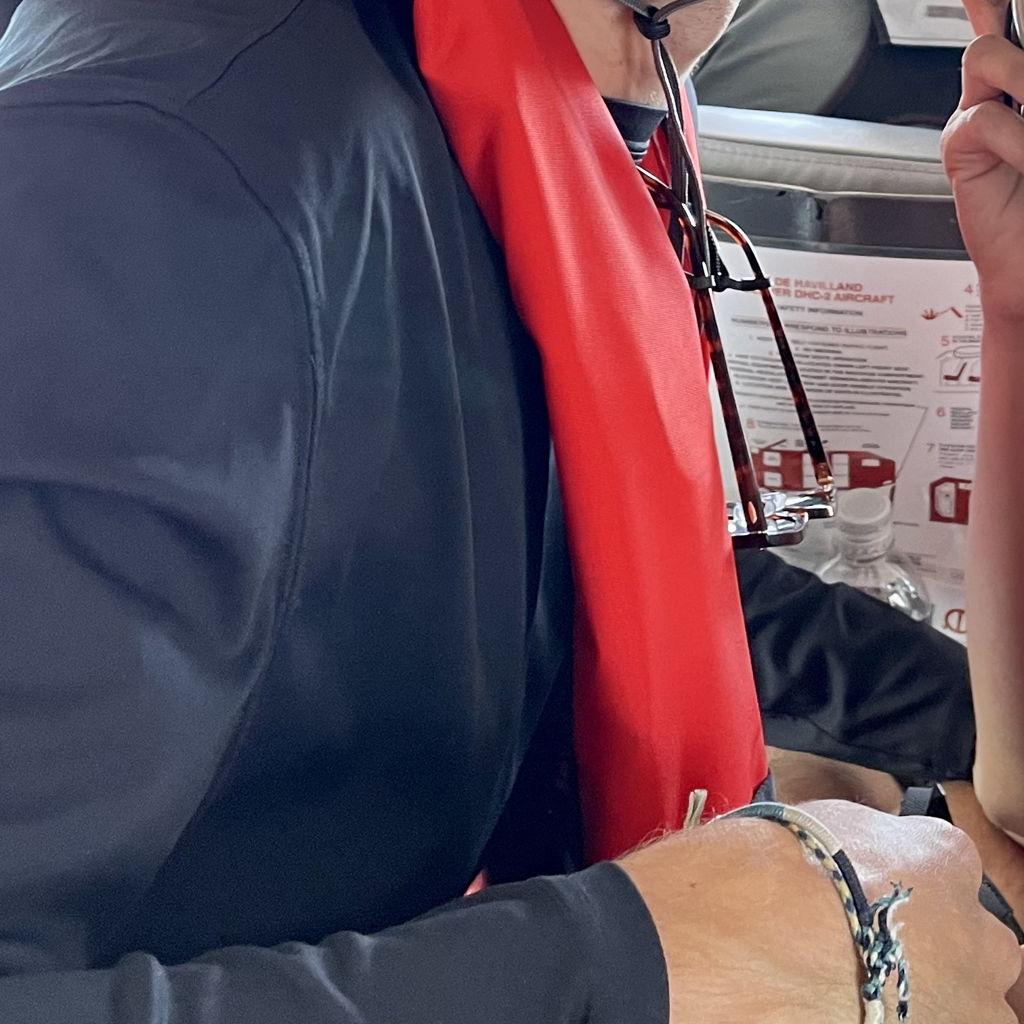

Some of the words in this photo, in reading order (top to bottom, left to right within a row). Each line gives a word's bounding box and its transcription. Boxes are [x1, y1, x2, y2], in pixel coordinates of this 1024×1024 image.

[964, 284, 974, 294] 4
[794, 289, 831, 301] DHC-2
[834, 292, 895, 304] AIRCRAFT
[940, 335, 951, 346] 5
